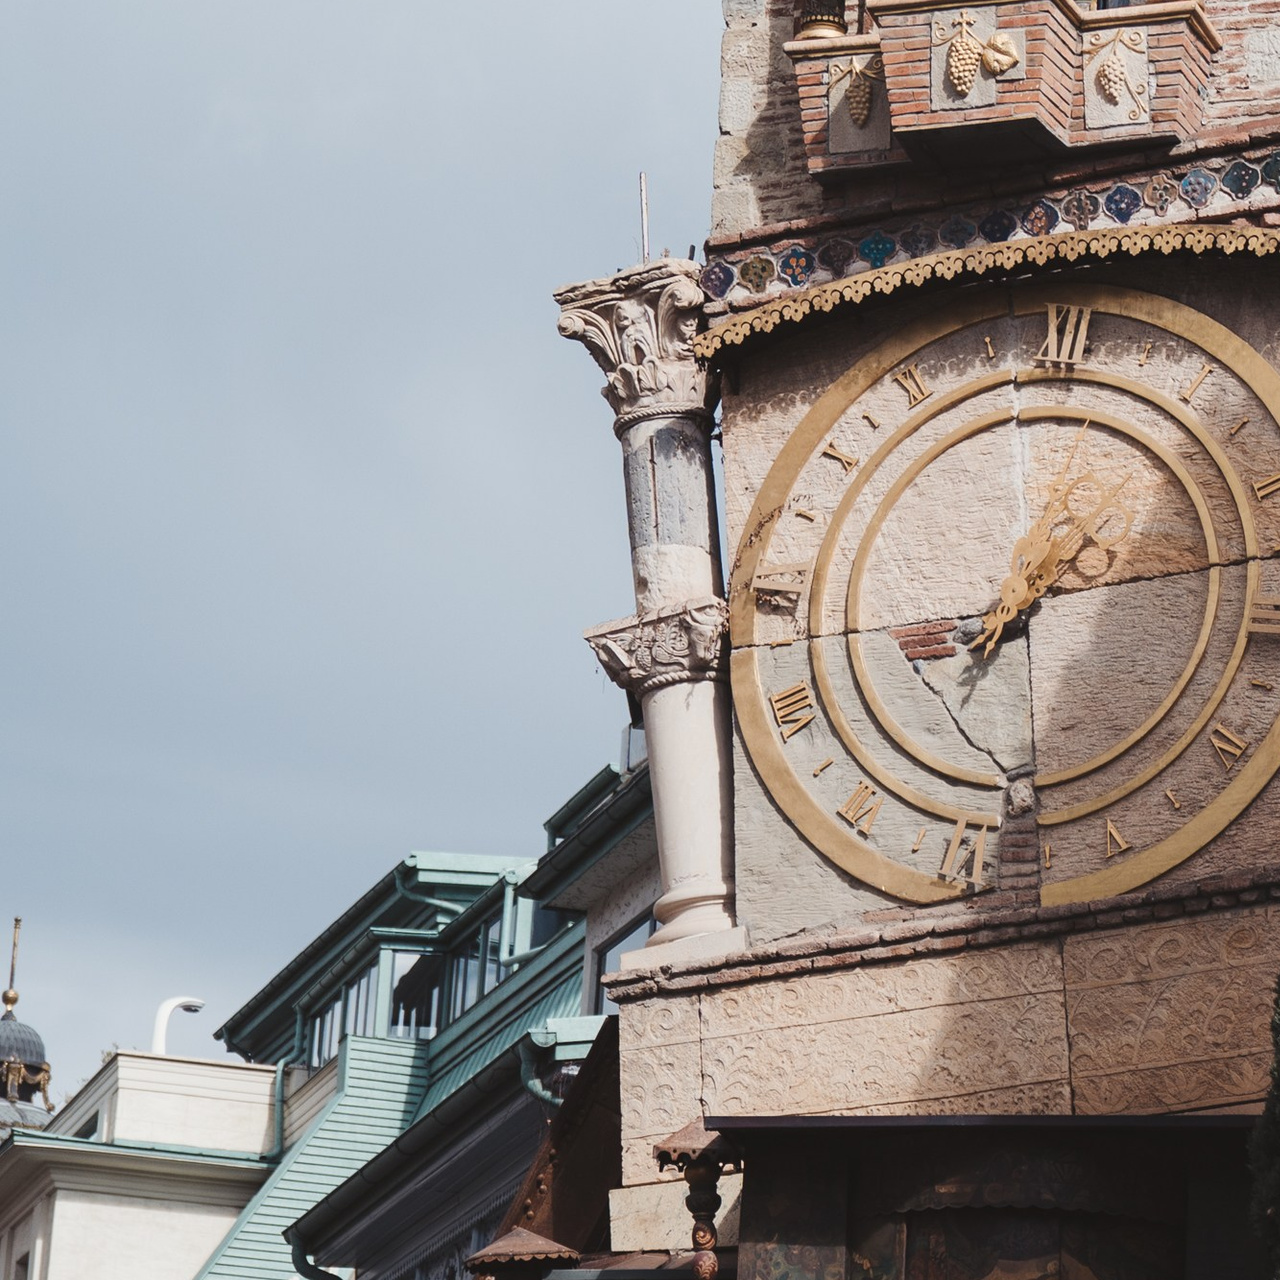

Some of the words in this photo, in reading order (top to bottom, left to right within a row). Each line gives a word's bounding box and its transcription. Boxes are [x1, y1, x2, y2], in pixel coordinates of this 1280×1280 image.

[1033, 303, 1093, 364] XII
[892, 363, 933, 409] XI
[819, 441, 859, 476] X
[771, 680, 816, 743] VIII
[1209, 722, 1249, 771] IV
[836, 781, 885, 836] VII
[938, 817, 988, 887] VI
[1105, 818, 1133, 858] V
